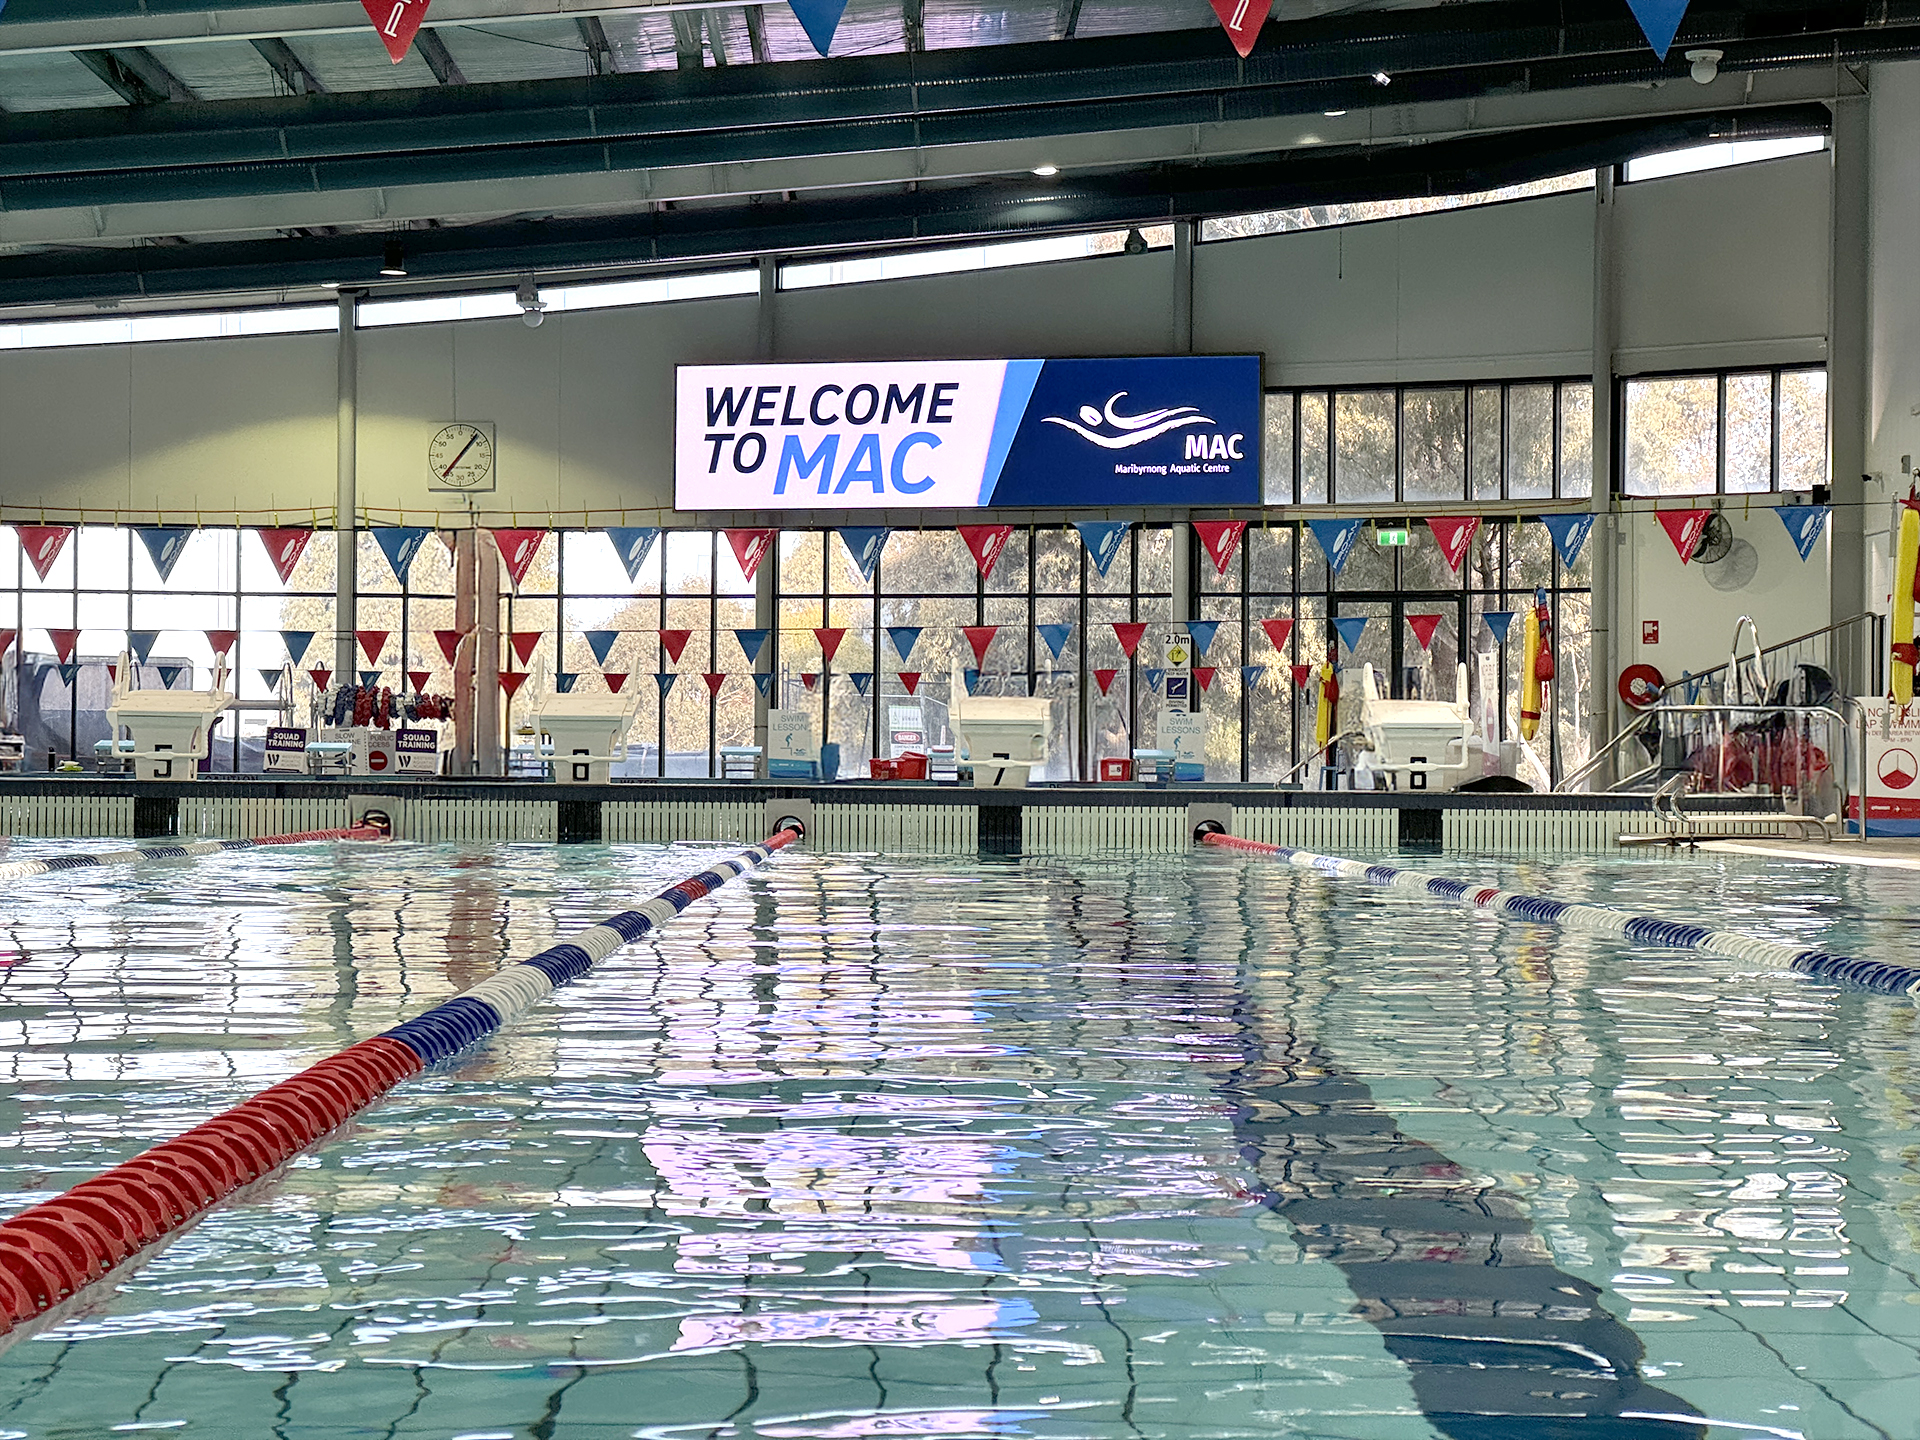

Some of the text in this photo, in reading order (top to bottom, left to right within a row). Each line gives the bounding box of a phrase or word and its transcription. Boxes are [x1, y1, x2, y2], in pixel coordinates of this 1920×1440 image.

[705, 382, 960, 427] WELCOME
[1184, 433, 1244, 460] MAC
[704, 431, 943, 495] TO MAC
[1114, 463, 1230, 475] Maribyrnong Aquatic Centre
[1165, 634, 1190, 645] 2.0m
[1888, 707, 1920, 718] PLI
[780, 714, 804, 723] SWIM
[1170, 717, 1193, 725] SWIM
[772, 723, 812, 731] LESSON
[1161, 726, 1201, 734] LESSONS
[273, 732, 300, 741] SQUAD
[402, 733, 431, 742] SQUAD
[268, 739, 304, 748] TRAINING
[397, 740, 435, 749] TRAINING
[154, 744, 172, 778] 5
[993, 753, 1010, 786] 7
